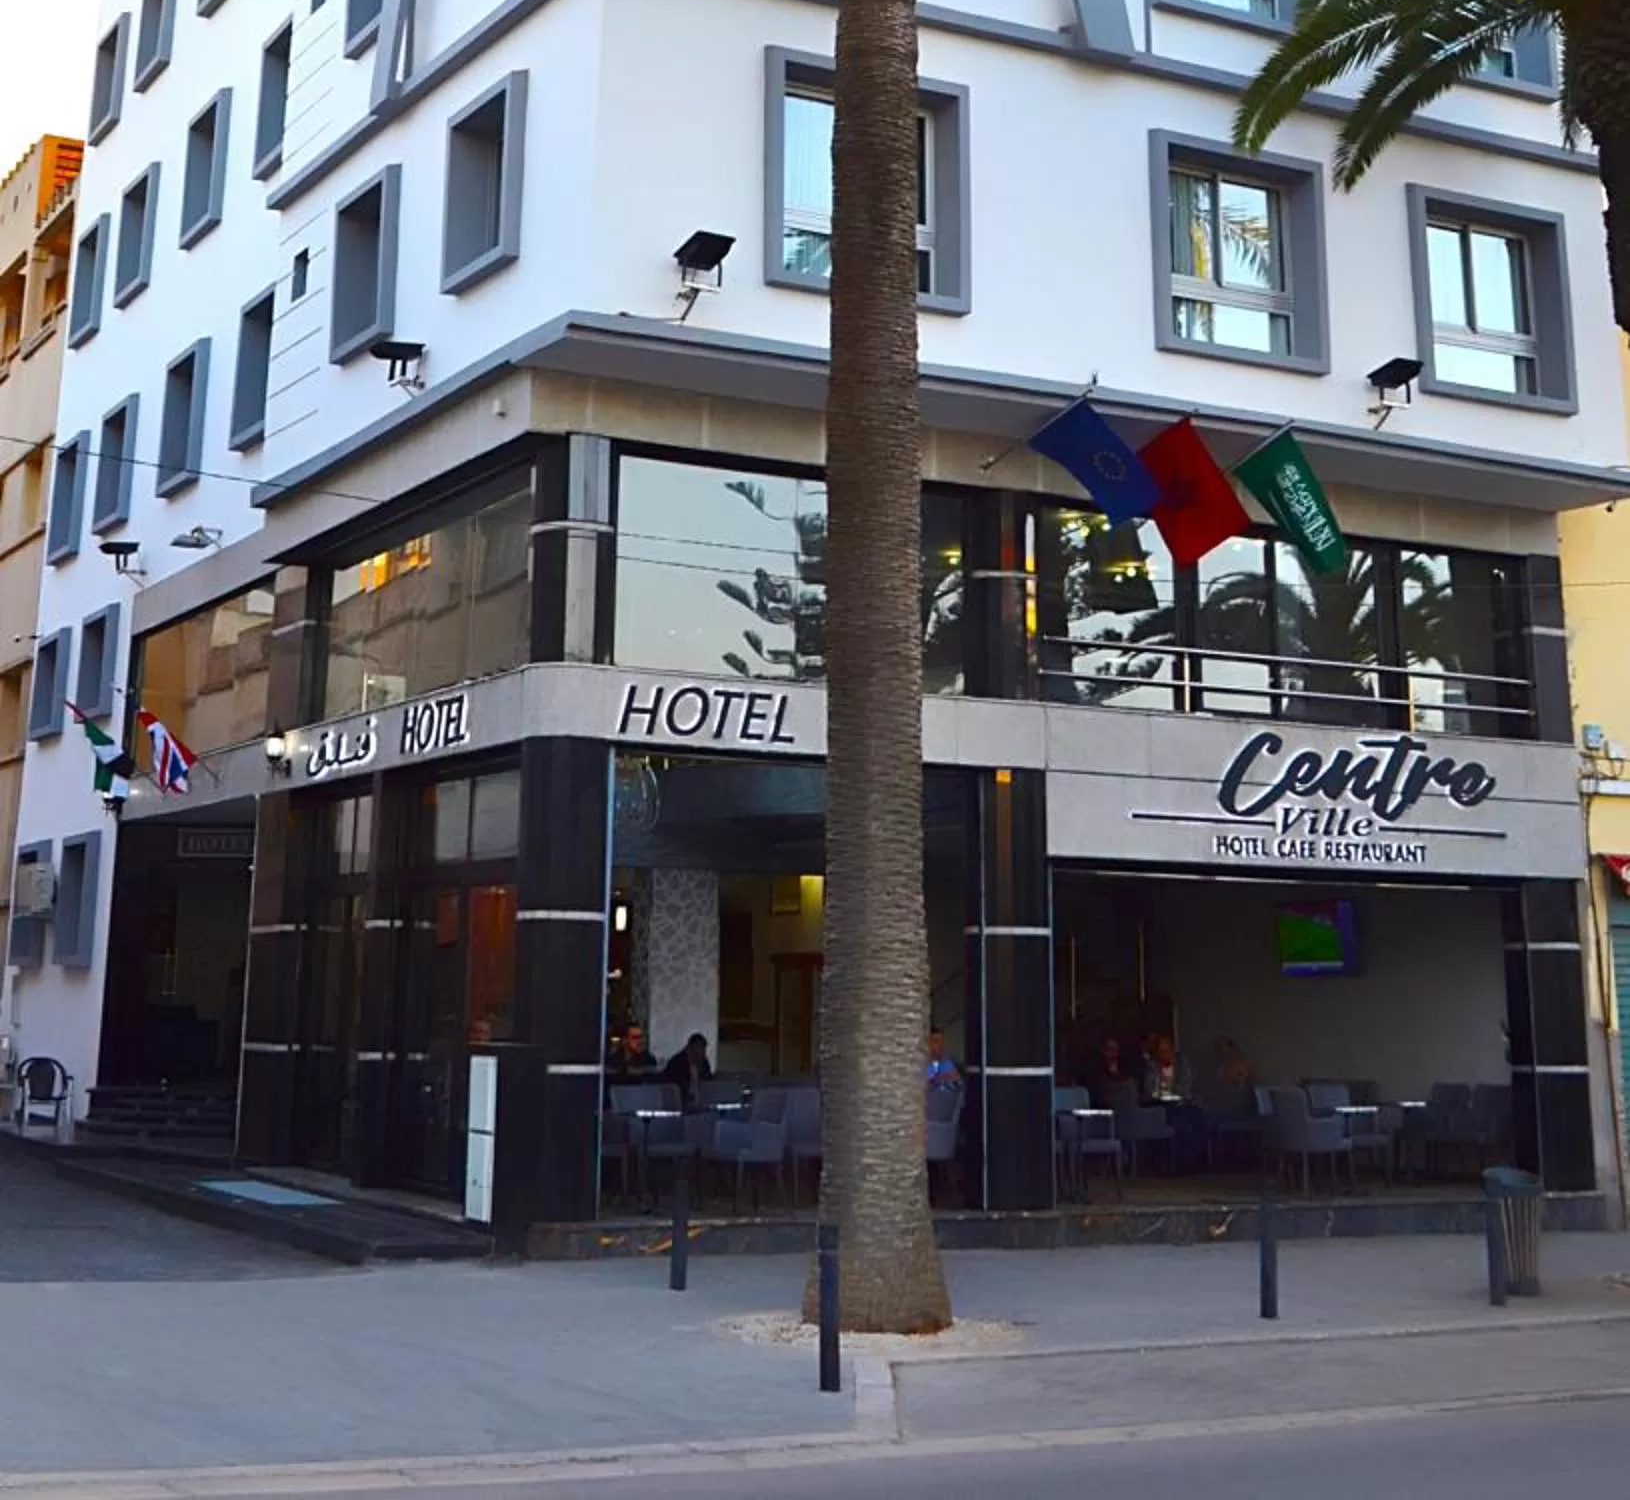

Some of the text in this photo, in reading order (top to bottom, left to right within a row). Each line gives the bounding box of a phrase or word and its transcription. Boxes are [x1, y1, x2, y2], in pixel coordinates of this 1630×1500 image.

[400, 693, 469, 754] HOTEL
[618, 685, 795, 744] HOTEL
[1218, 730, 1497, 822] Centre
[1215, 835, 1427, 863] HOTEL CAFE RESTAURANT
[1280, 807, 1374, 837] Ville
